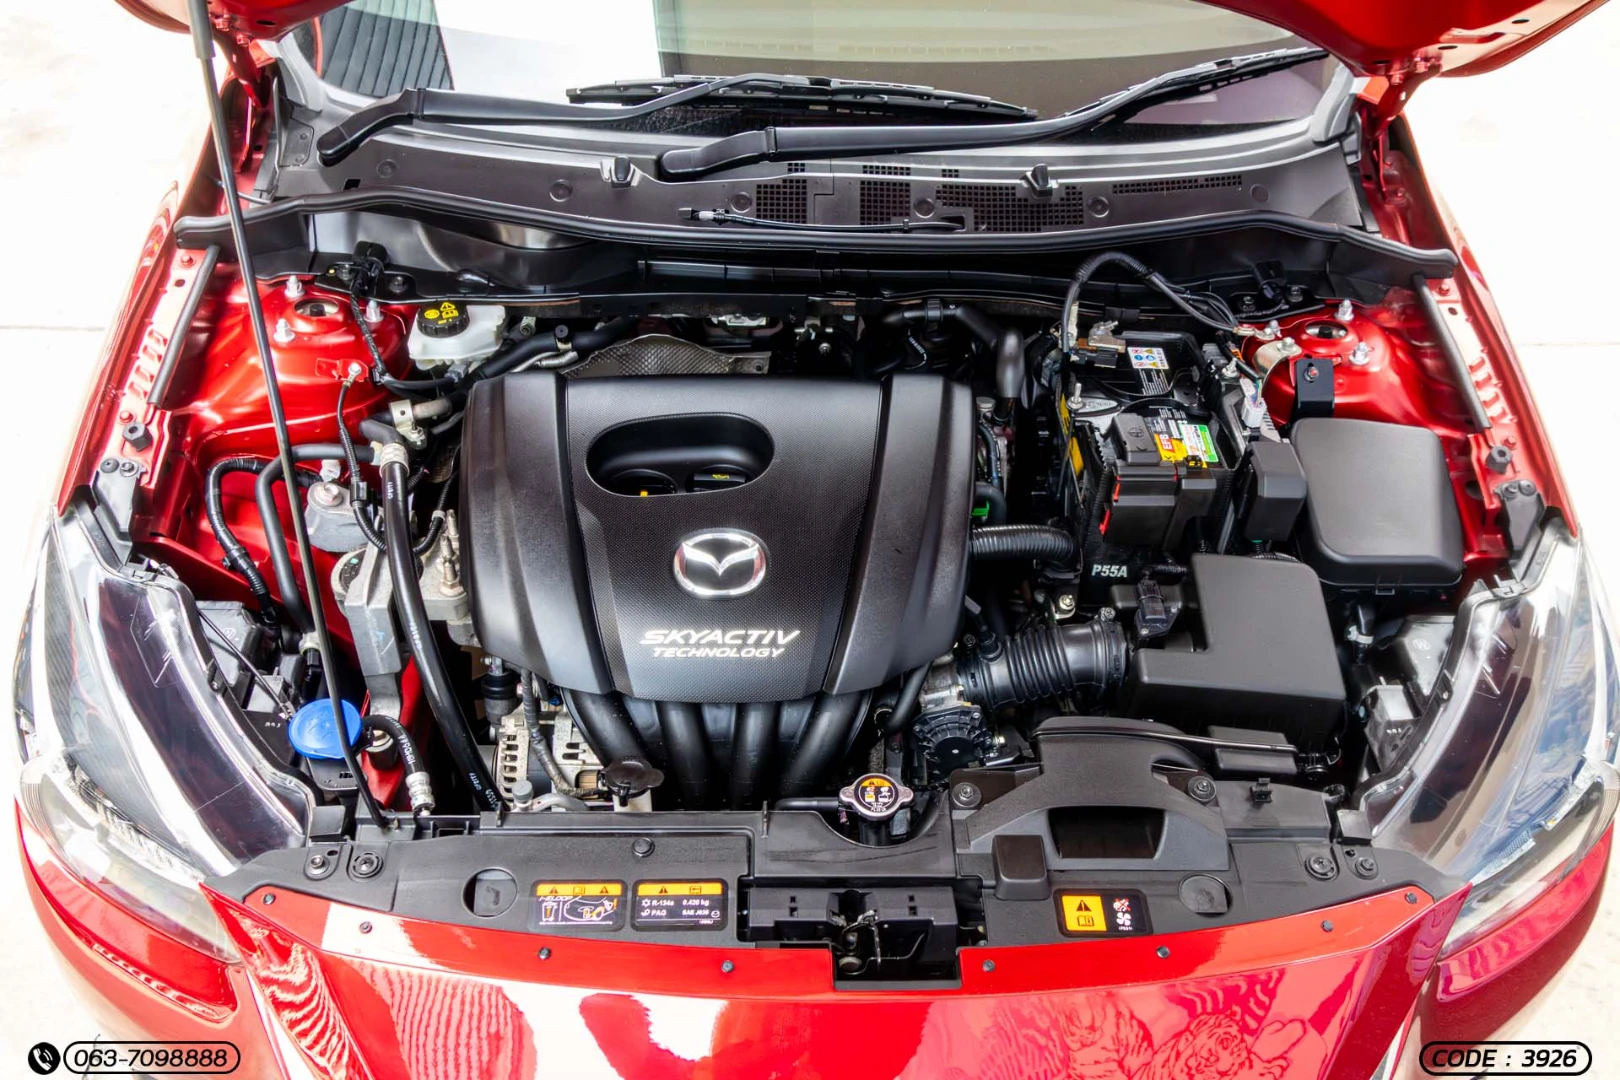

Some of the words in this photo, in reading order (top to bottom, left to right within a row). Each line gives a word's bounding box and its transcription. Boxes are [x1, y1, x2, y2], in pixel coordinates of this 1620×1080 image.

[1091, 563, 1128, 578] P55A
[639, 629, 801, 645] SKYACTIV
[652, 647, 785, 658] TECHNOLOGY
[700, 899, 710, 907] kg
